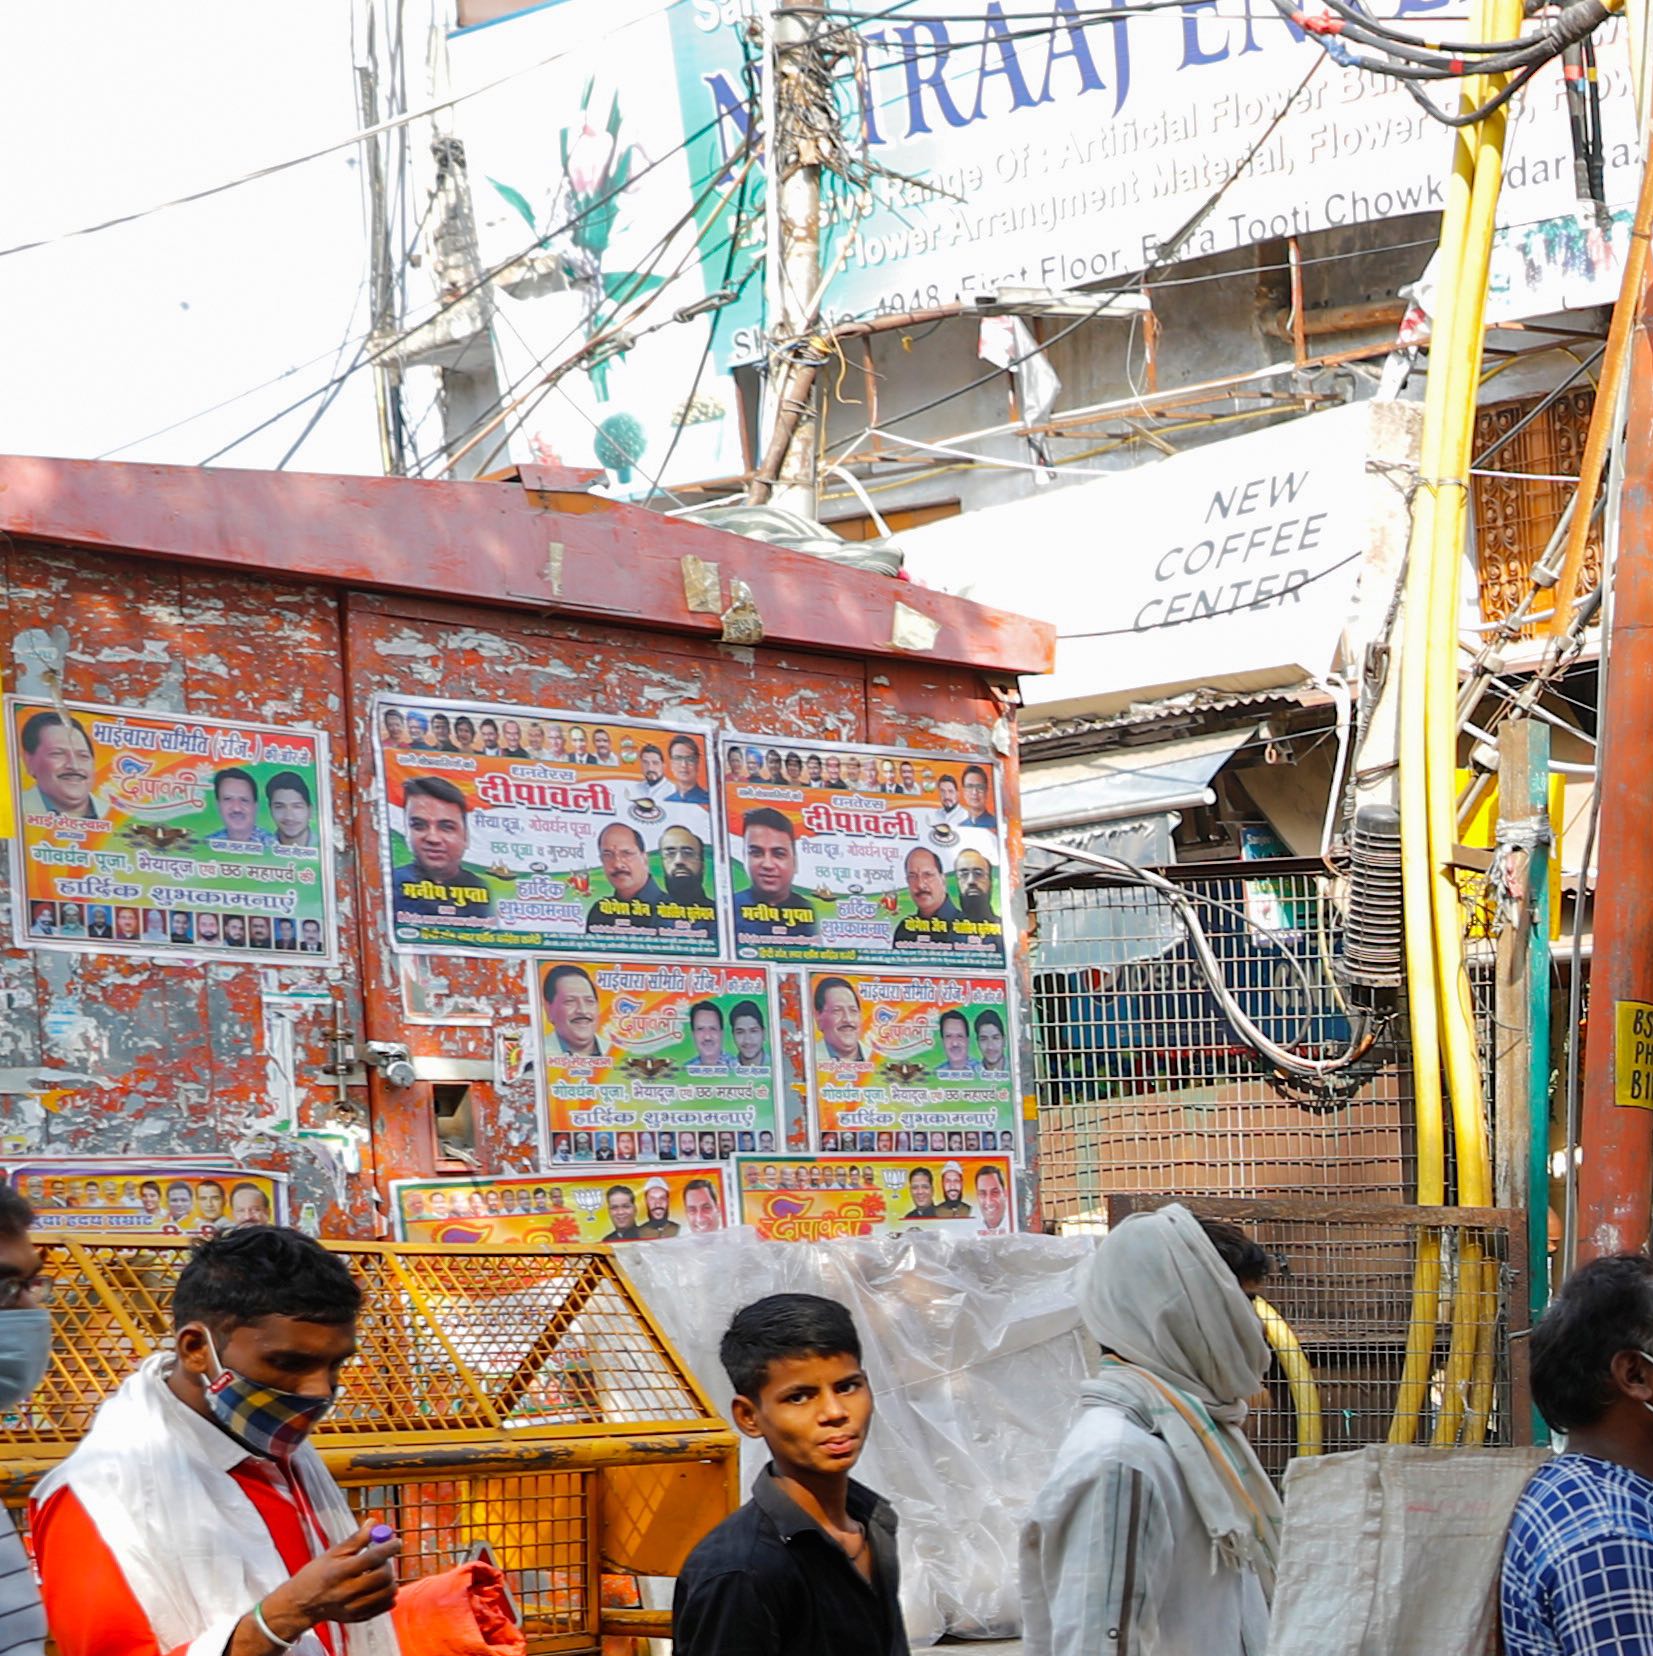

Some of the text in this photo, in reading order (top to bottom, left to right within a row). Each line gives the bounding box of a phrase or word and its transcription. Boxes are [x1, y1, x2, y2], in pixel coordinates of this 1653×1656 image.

[1060, 103, 1198, 169] Artificial
[951, 170, 1141, 247] Arrangment
[1228, 201, 1311, 245] Tooti
[1324, 173, 1445, 229] Chowk
[1204, 470, 1310, 524] NEW
[1154, 512, 1329, 582] COFFEE
[1132, 568, 1310, 633] CENTER
[477, 773, 616, 814] दीपावली
[803, 804, 918, 839] दीपावली
[56, 875, 140, 899] हार्दिक
